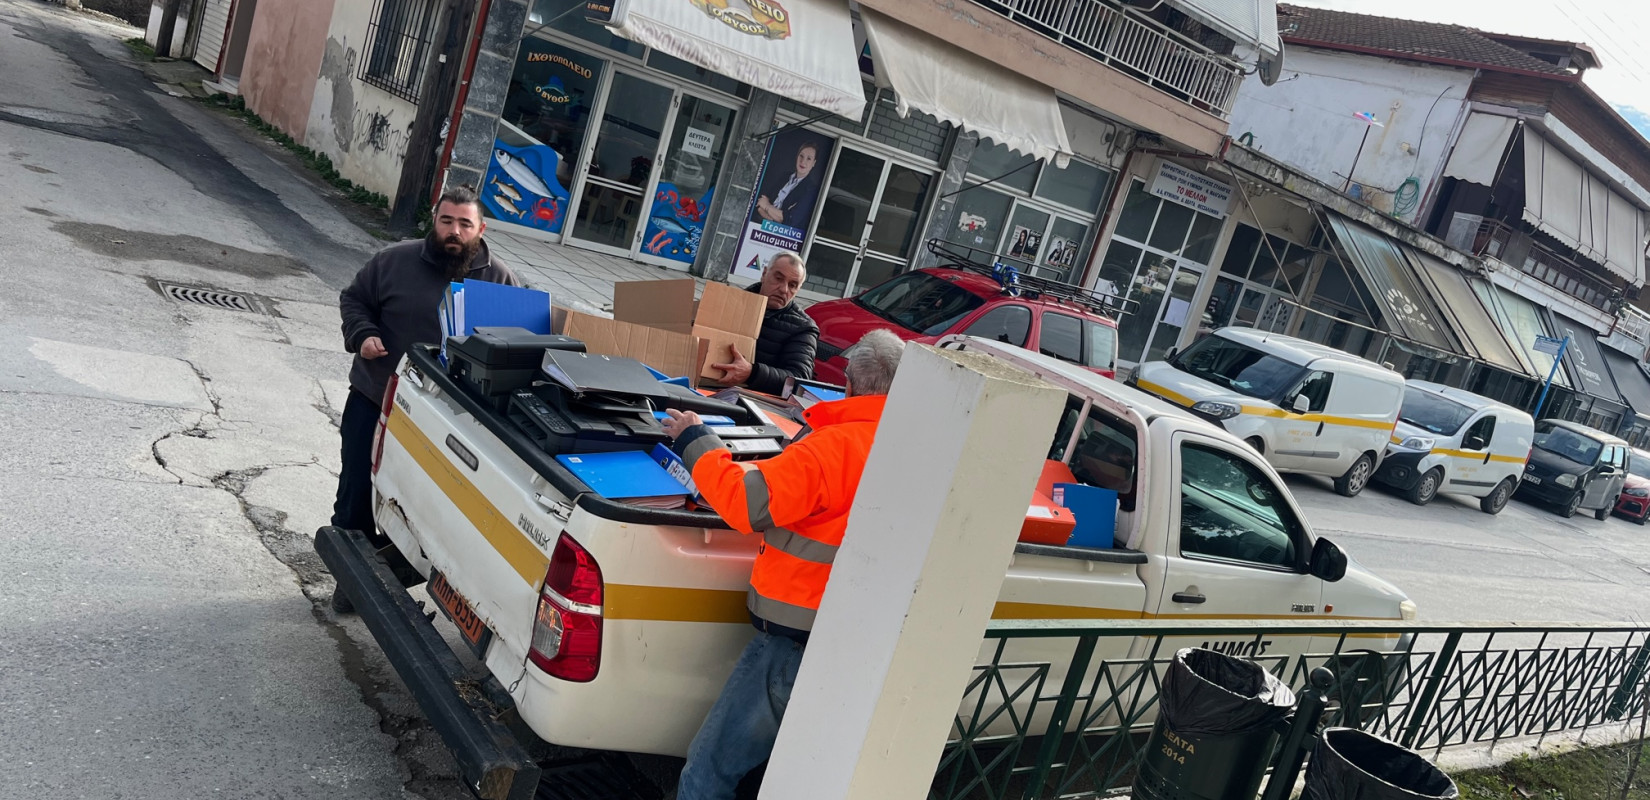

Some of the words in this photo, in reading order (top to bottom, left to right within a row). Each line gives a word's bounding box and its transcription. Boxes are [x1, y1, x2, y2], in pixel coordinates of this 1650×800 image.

[712, 8, 722, 17] Ο
[723, 14, 766, 33] ΒΥΘΟΣ
[527, 52, 592, 79] ΙΧΘΥΟΠΩΛΕΙΟ
[535, 85, 542, 93] Ο
[541, 91, 570, 103] ΒΥΘΟΣ
[688, 132, 711, 143] ΔΕΥΤΕΡΑ
[1177, 186, 1185, 194] ΤΟ
[1185, 190, 1207, 203] ΜΕΛΛΟΝ
[764, 221, 802, 239] Γερακίνα
[753, 231, 799, 250] Μπισμπινά
[517, 512, 550, 551] HILUX
[1163, 728, 1195, 754] ΔΕΛΤΑ
[1162, 744, 1185, 764] 2014
